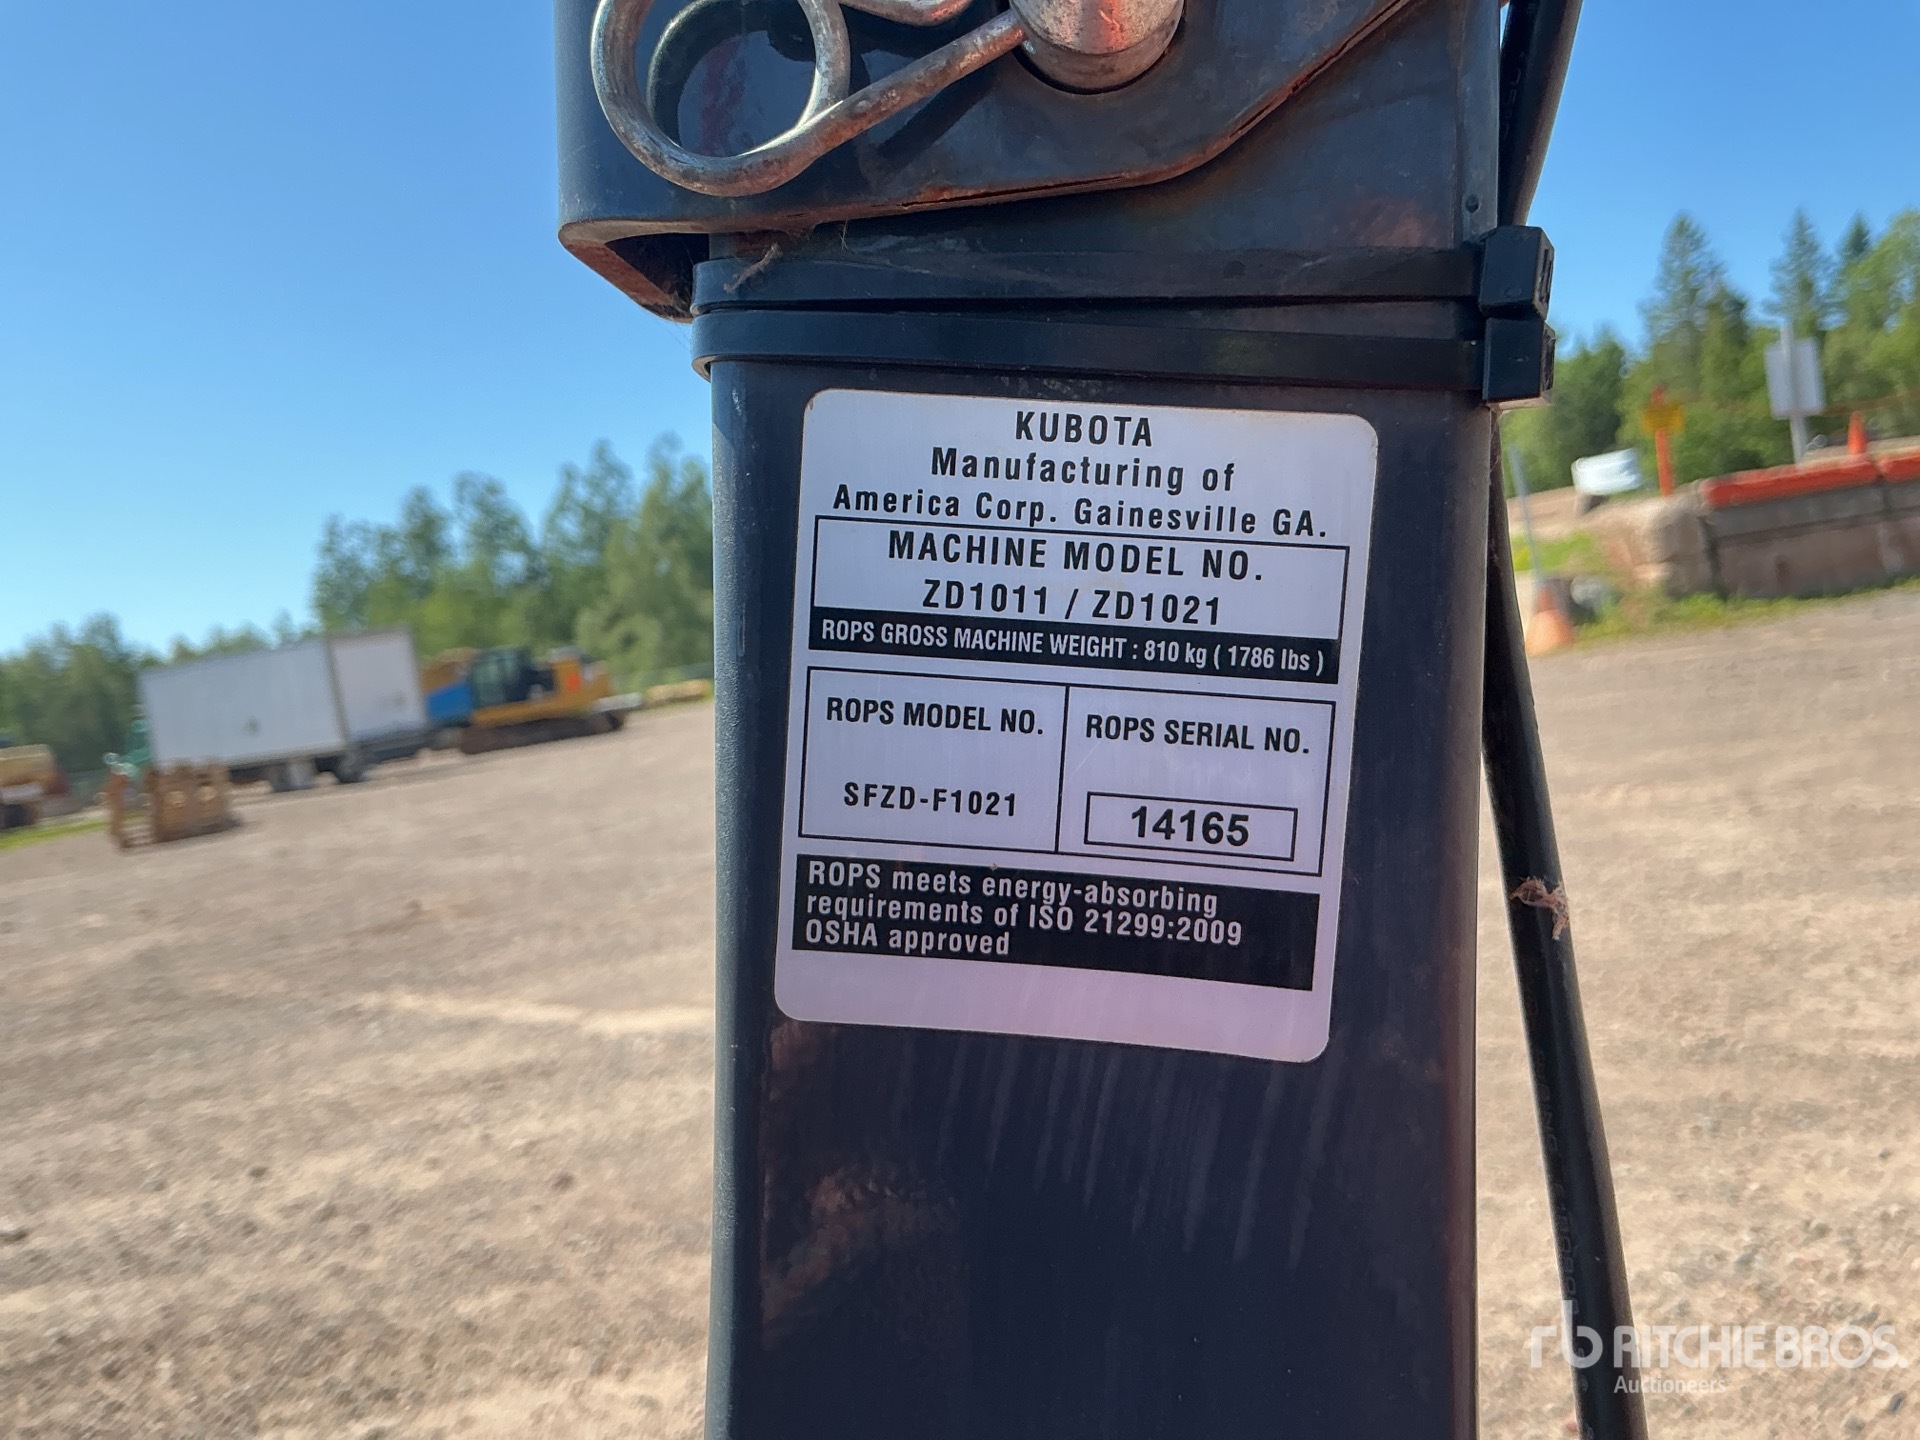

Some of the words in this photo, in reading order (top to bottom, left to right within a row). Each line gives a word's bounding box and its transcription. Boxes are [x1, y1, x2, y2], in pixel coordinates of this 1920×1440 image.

[1015, 410, 1152, 447] KUBOTA
[931, 446, 1184, 496] Manufacturing
[1202, 462, 1235, 492] of
[832, 483, 960, 517] America
[975, 491, 1057, 528] Corp.
[1074, 497, 1256, 534] Gainesville
[1272, 508, 1326, 538] GA.
[888, 529, 1047, 568] MACHINE
[1063, 540, 1184, 576] MODEL
[1202, 549, 1262, 581] NO.
[922, 578, 1047, 615] ZD1011
[1091, 589, 1219, 626] ZD1021
[821, 618, 875, 643] ROPS
[880, 622, 948, 648] GROSS
[953, 627, 1044, 654] MACHINE
[1049, 633, 1128, 659] WEIGHT
[1144, 639, 1180, 663] 810
[1184, 642, 1207, 669] kg
[1227, 645, 1275, 669] 1786
[1280, 648, 1311, 671] lbs
[826, 696, 894, 725] ROPS
[903, 701, 992, 731] MODEL
[1000, 708, 1043, 735] NO.
[1085, 714, 1155, 743] ROPS
[1163, 719, 1255, 750] SERIAL
[1264, 726, 1309, 754] NO.
[843, 781, 1015, 817] SFZD-F1021
[1131, 805, 1249, 847] 14165
[808, 860, 881, 889] ROPS
[892, 870, 971, 895] meets
[982, 876, 1218, 919] energy-absorbing
[805, 918, 878, 947] OSHA
[888, 929, 1010, 955] approved
[807, 893, 983, 925] requirements
[994, 902, 1019, 927] of
[1029, 904, 1074, 931] ISO
[1084, 908, 1242, 946] 21299:2009
